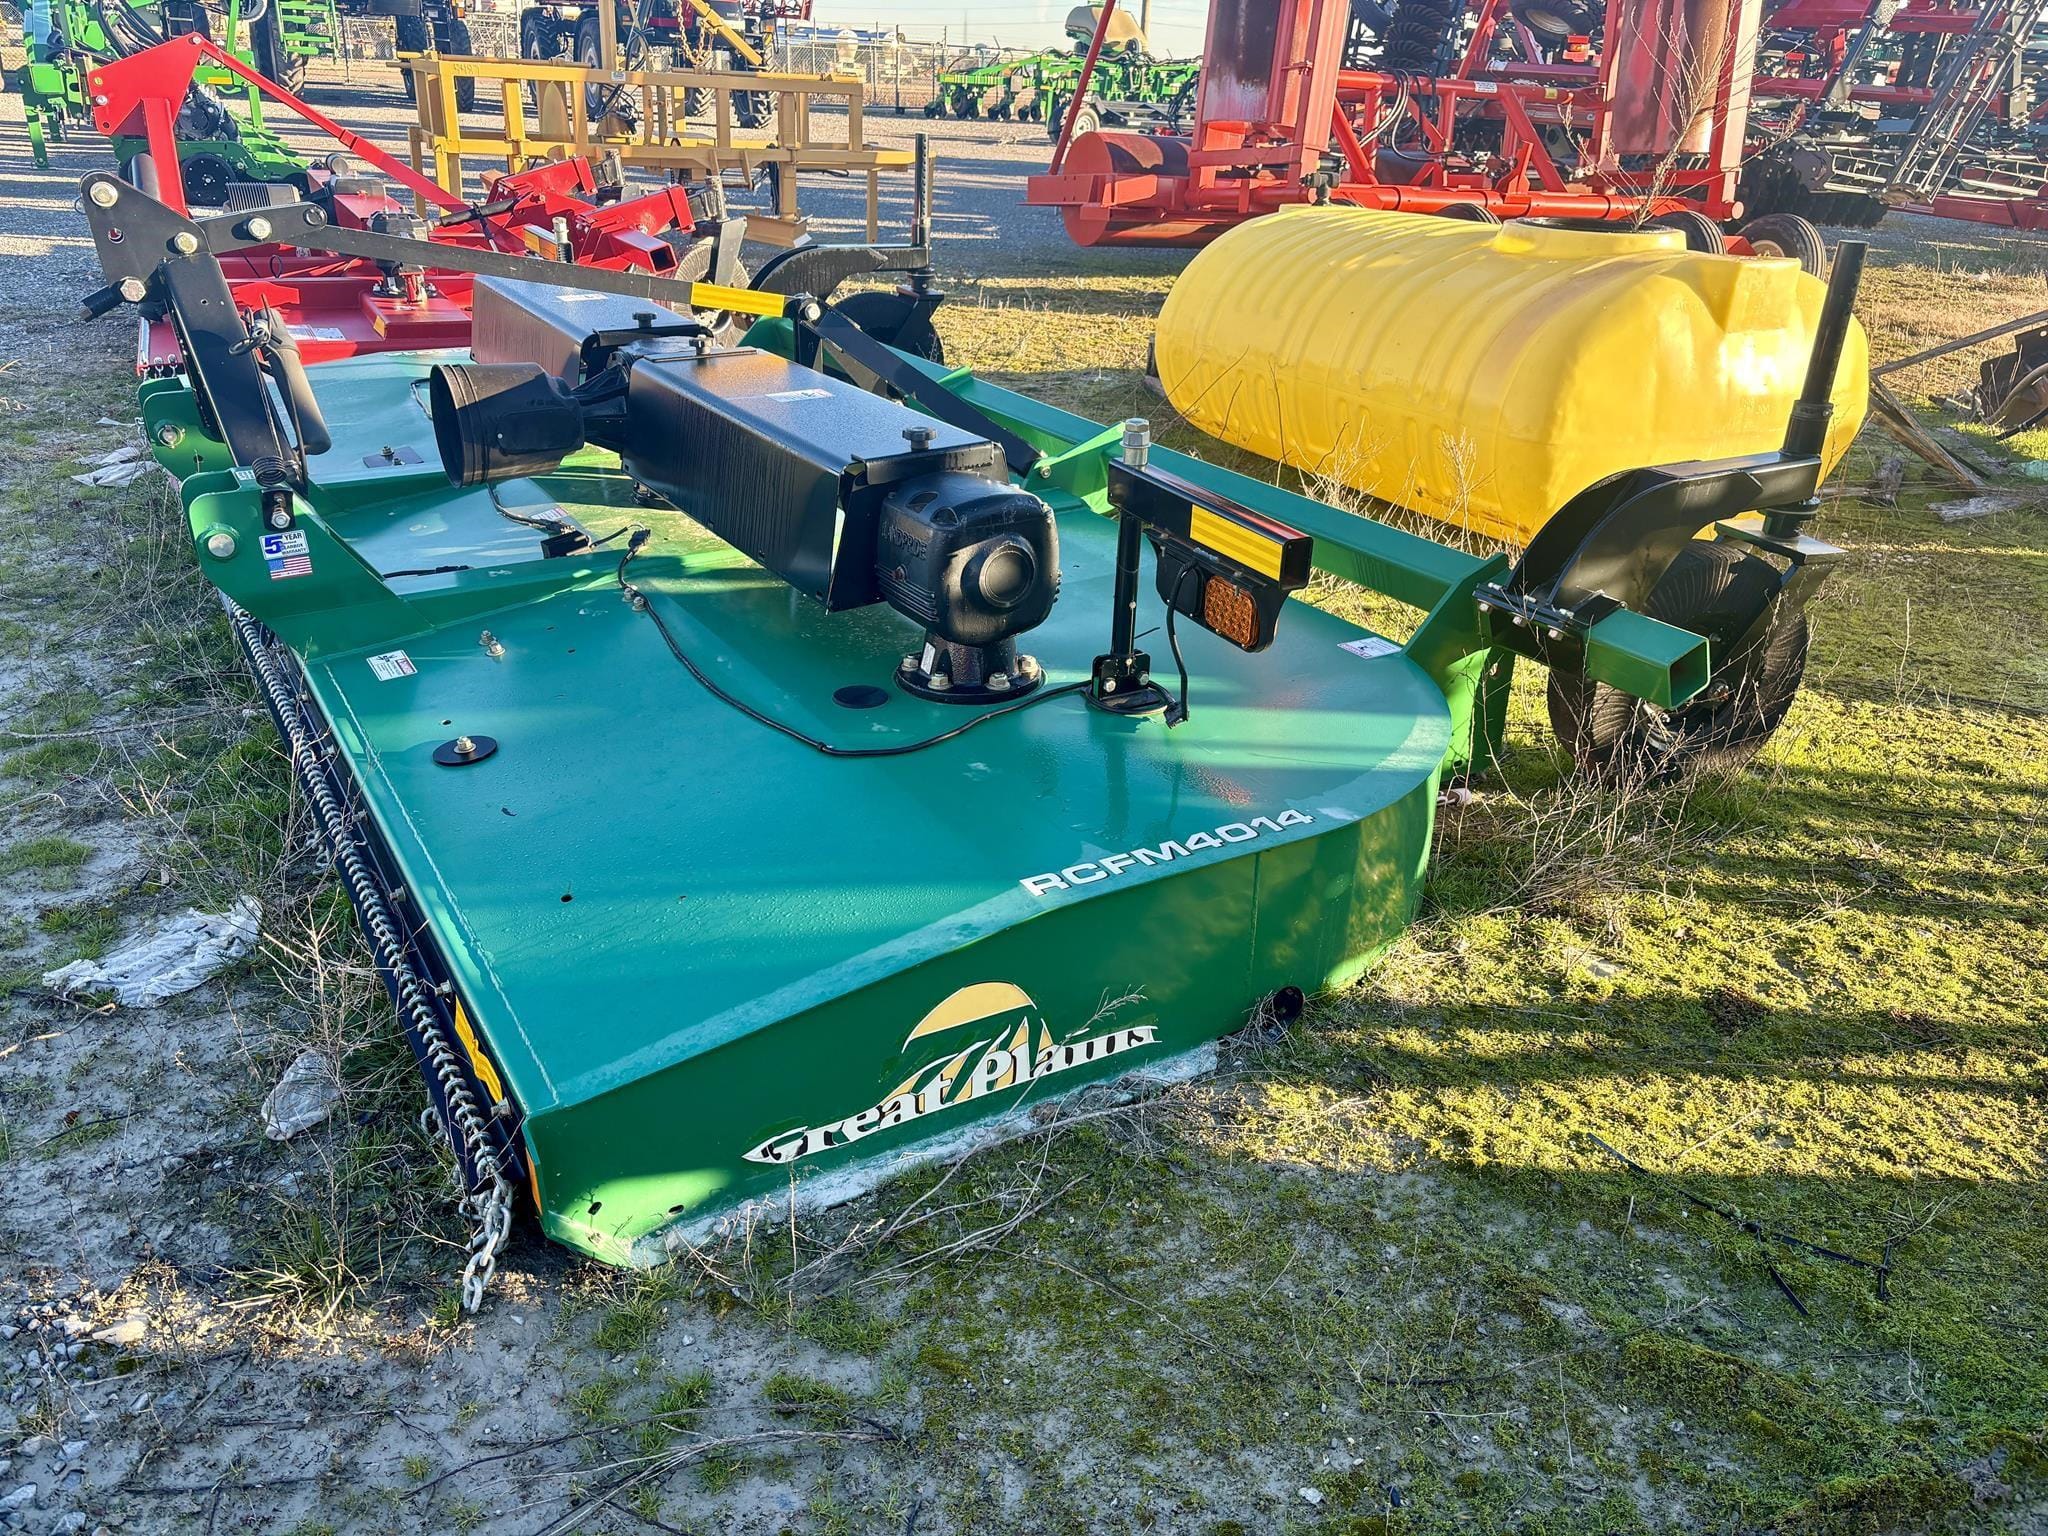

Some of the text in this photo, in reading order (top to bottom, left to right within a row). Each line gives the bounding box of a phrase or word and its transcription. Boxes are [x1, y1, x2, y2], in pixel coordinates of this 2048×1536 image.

[265, 532, 303, 554] 5 YEAR
[1019, 808, 1317, 897] RCFM4014
[741, 1024, 1164, 1164] Great Plains
